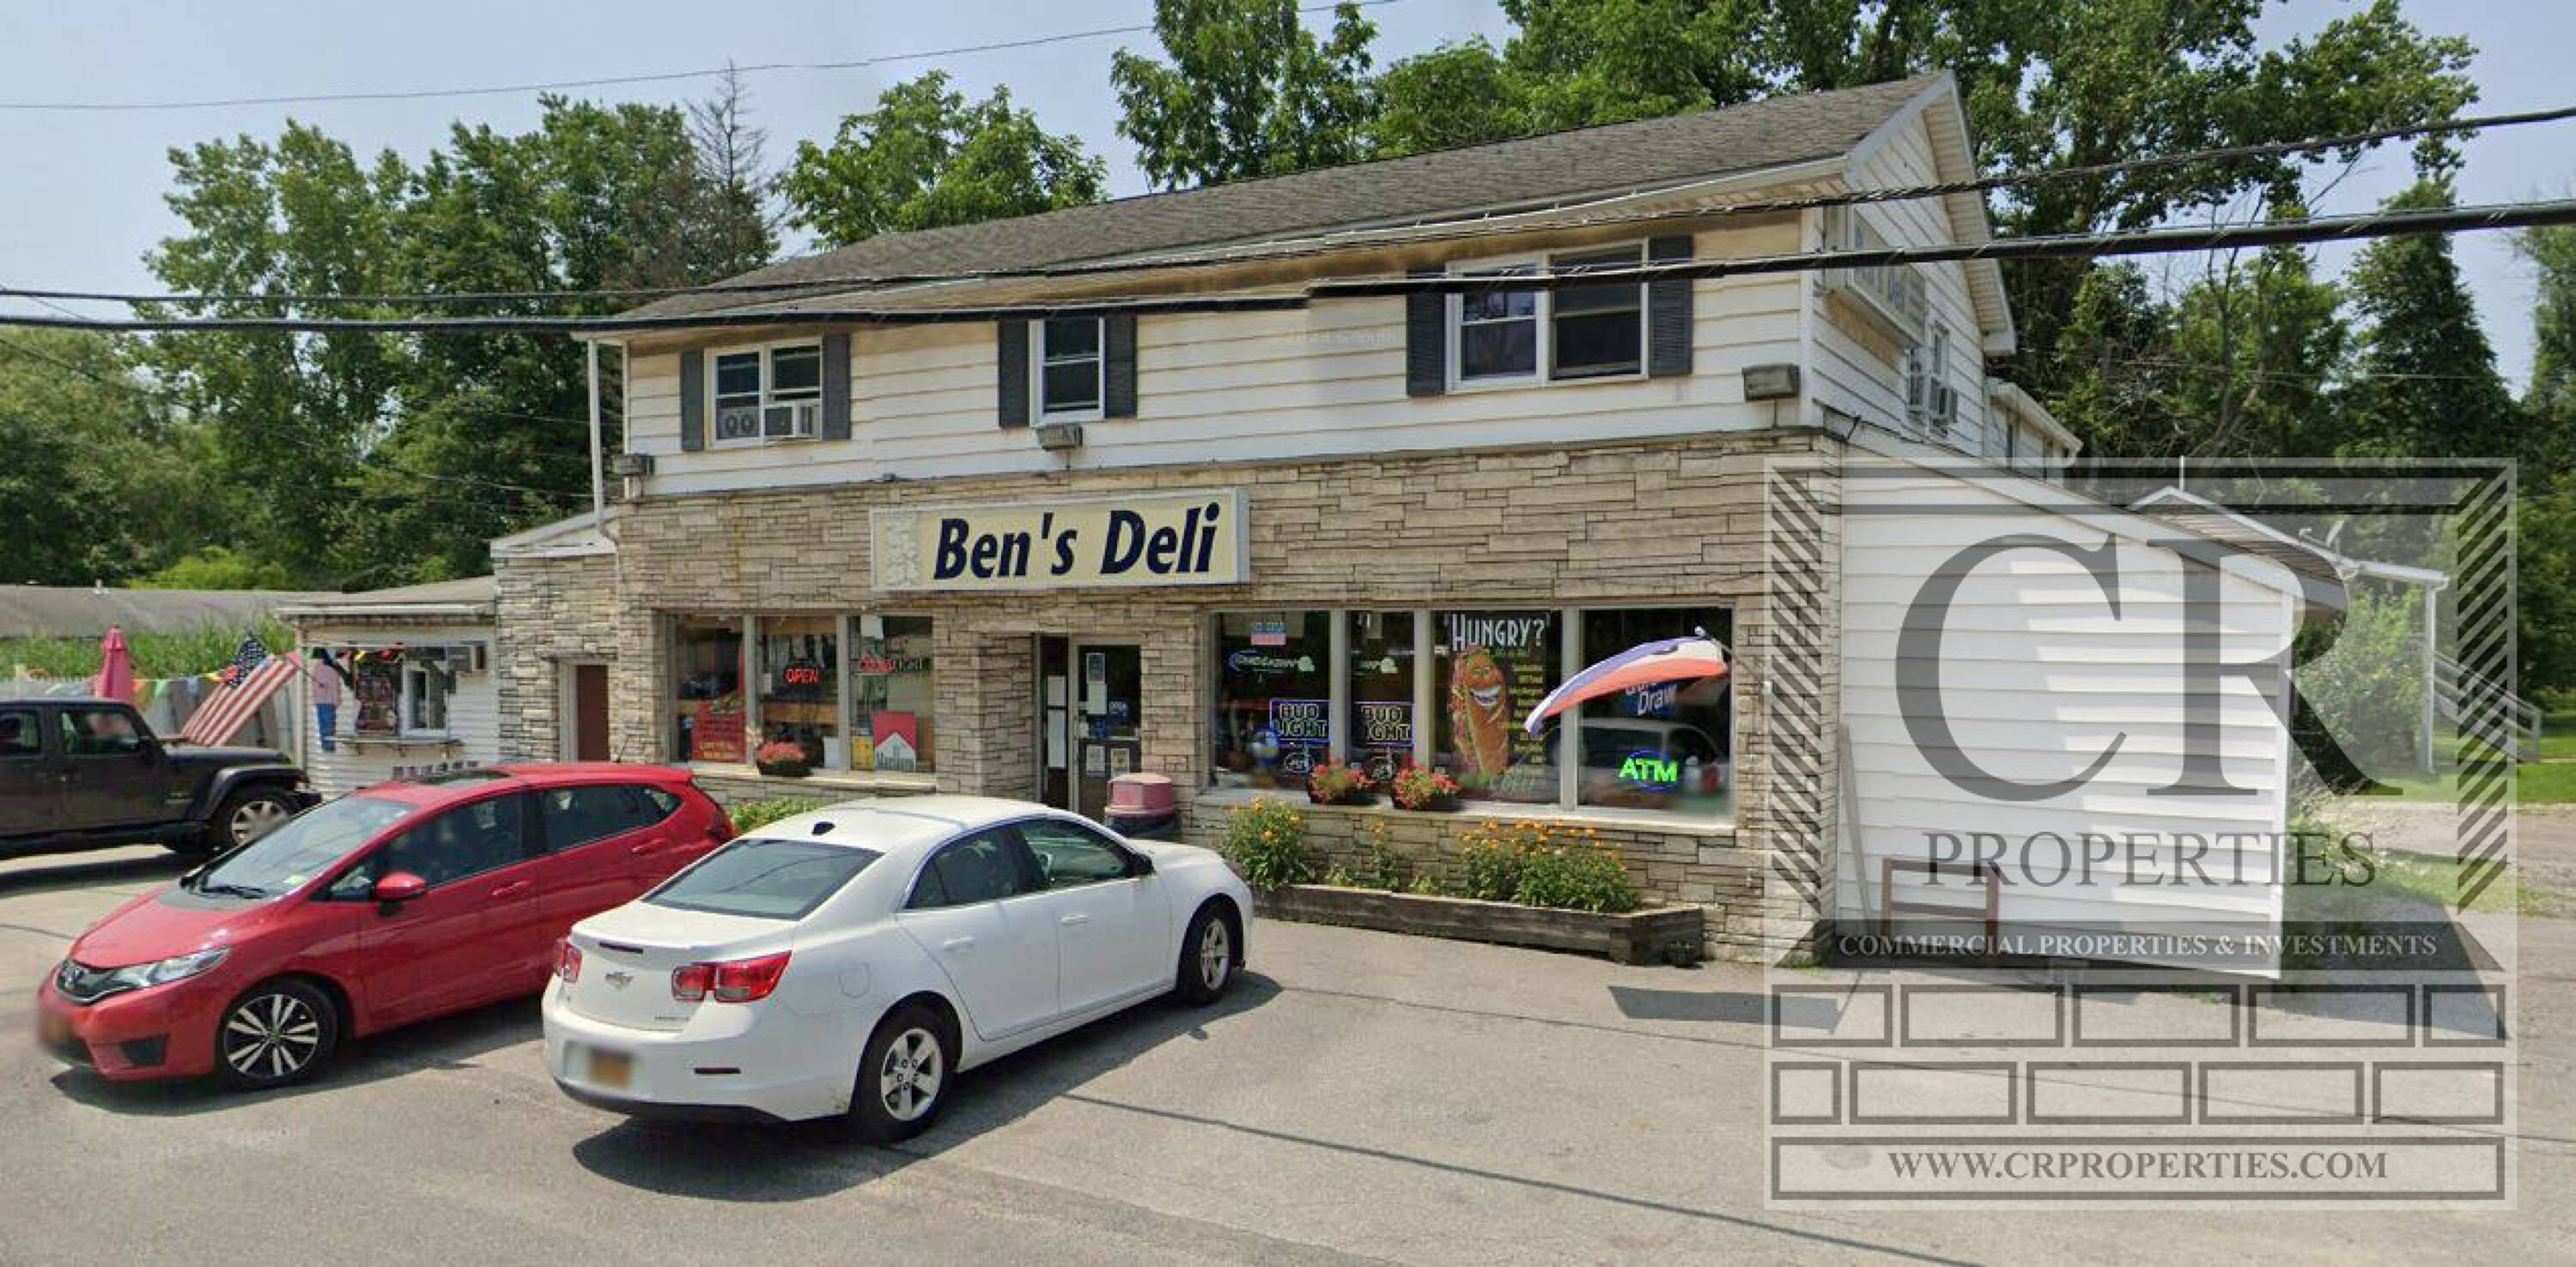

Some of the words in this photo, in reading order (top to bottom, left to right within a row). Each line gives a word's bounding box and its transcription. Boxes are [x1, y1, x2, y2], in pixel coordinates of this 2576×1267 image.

[933, 512, 1078, 579] Ben's
[1100, 501, 1220, 574] Deli
[1452, 614, 1545, 652] HUNGRY?
[786, 668, 818, 683] OPEN
[1279, 703, 1319, 719] BUD
[1361, 706, 1403, 723] BUD
[1367, 723, 1413, 741] IGHT
[1619, 756, 1677, 782] ATM
